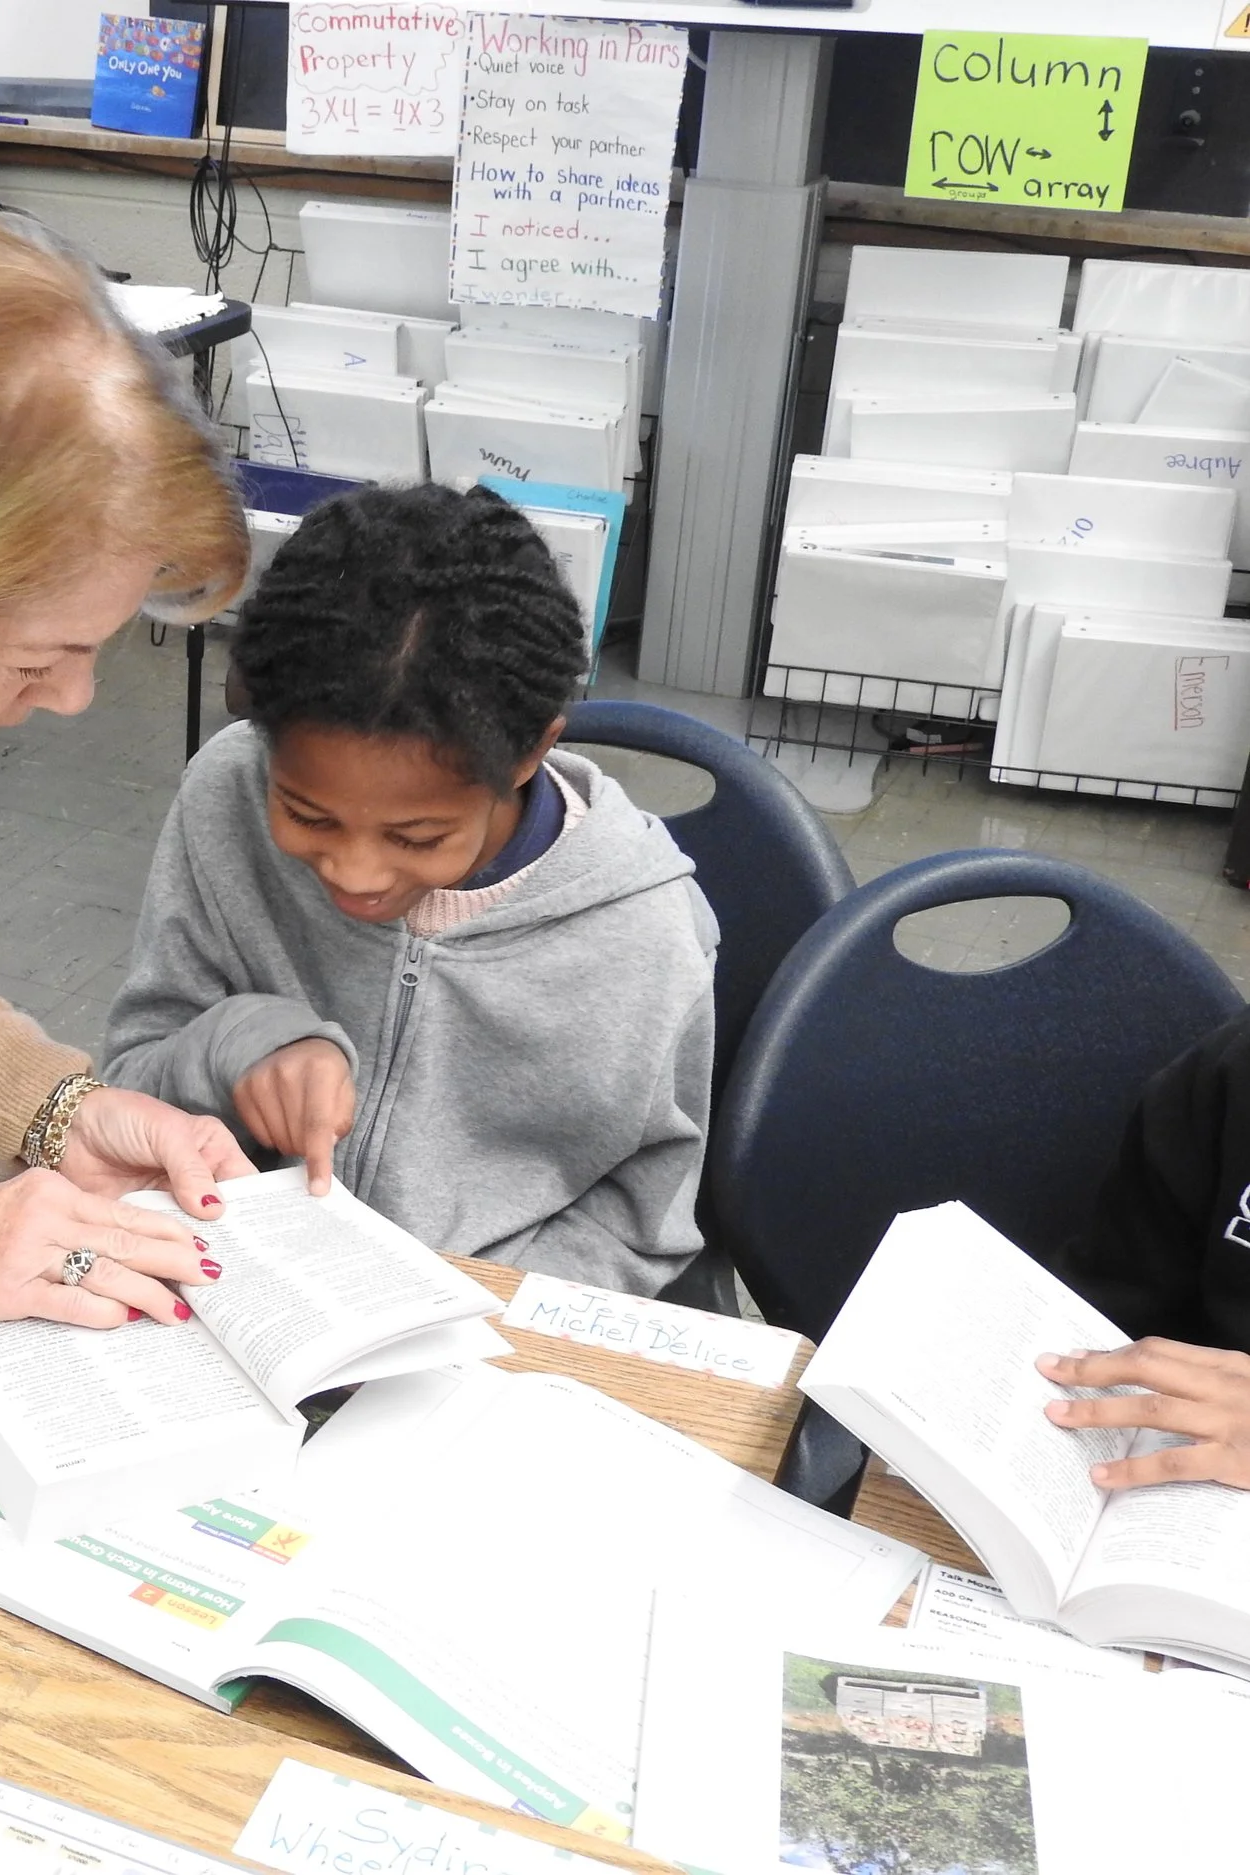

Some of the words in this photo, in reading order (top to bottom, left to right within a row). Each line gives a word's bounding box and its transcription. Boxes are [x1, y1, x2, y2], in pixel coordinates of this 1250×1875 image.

[297, 9, 458, 38] Commutative
[478, 20, 589, 77] Working
[598, 29, 618, 61] in
[624, 28, 681, 70] Pairs
[300, 42, 416, 86] Property
[478, 53, 520, 75] Quiet
[529, 58, 565, 75] voice
[933, 37, 1122, 92] Column
[476, 91, 515, 117] Stay
[525, 98, 547, 113] on
[556, 93, 590, 115] task
[472, 126, 538, 154] Respect
[551, 134, 583, 155] your
[589, 134, 646, 158] partner
[470, 161, 516, 184] How
[526, 161, 545, 184] to
[557, 165, 604, 190] share
[615, 173, 660, 197] ideas
[493, 183, 532, 203] with
[550, 190, 562, 203] a
[1023, 177, 1110, 208] array
[469, 213, 490, 238] I
[467, 248, 487, 271] I
[500, 257, 561, 284] agree
[460, 283, 479, 300] I
[1164, 454, 1242, 479] Aubree
[1179, 655, 1230, 729] Emerson
[568, 1293, 689, 1341] Jessy
[530, 1302, 638, 1343] Michel
[649, 1327, 756, 1372] Delice
[107, 1551, 142, 1574] Each
[158, 1571, 200, 1596] Many
[167, 1600, 217, 1625] Lesson
[200, 1590, 236, 1612] How
